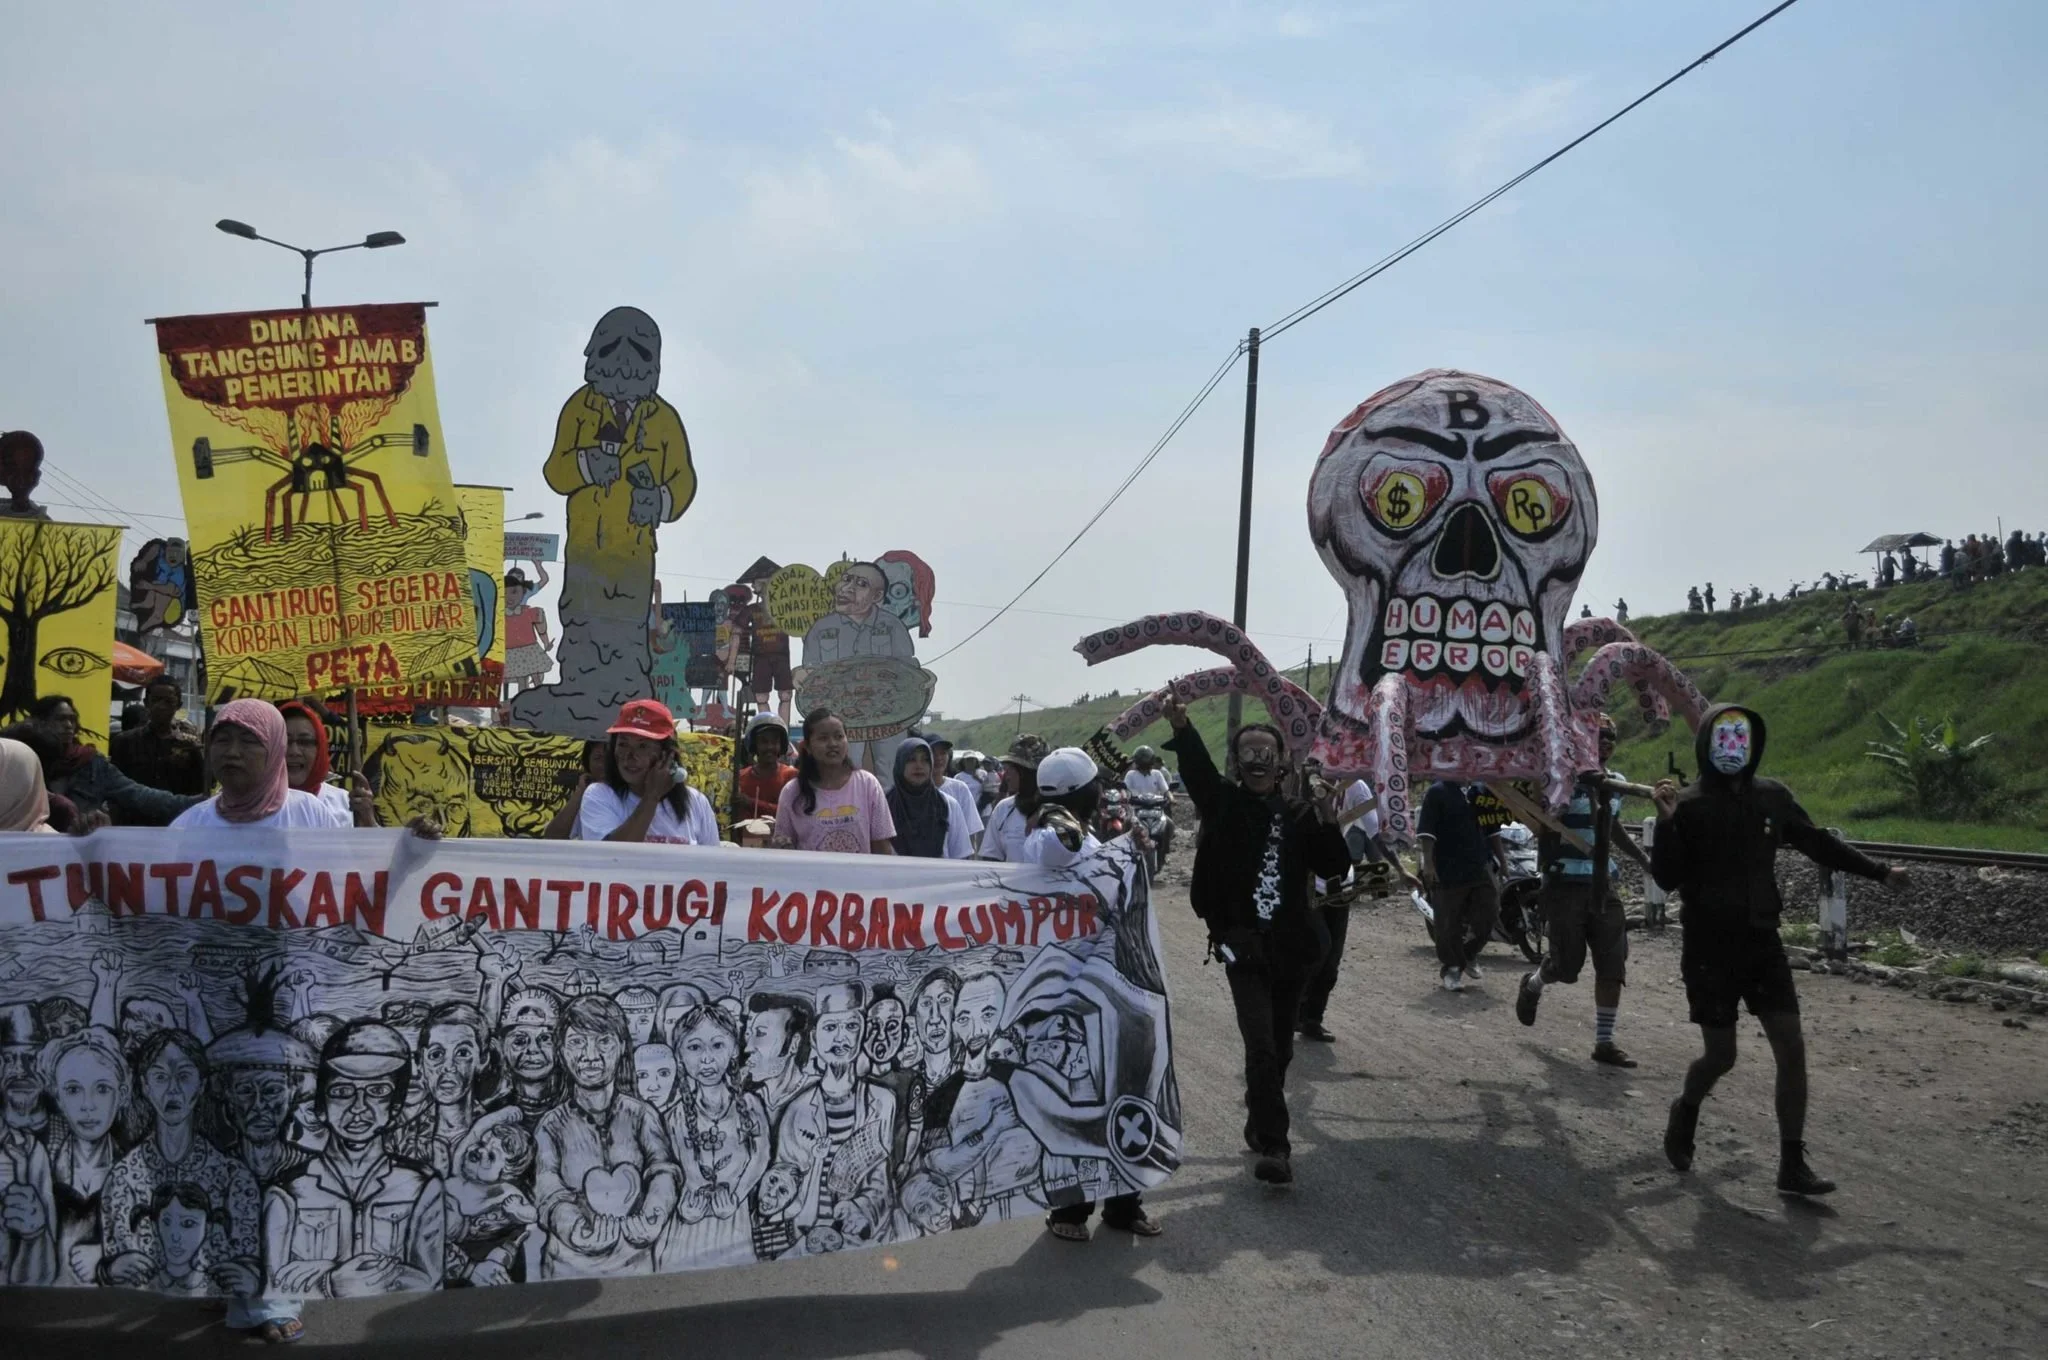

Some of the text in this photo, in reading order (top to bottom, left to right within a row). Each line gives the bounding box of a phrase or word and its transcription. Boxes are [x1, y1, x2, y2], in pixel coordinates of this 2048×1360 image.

[250, 313, 359, 344] DIMANA
[180, 338, 418, 378] TANGGUNG JAWAB
[224, 366, 391, 404] PEMERINTAH
[1439, 389, 1491, 430] B
[1511, 488, 1545, 530] Rp
[768, 584, 806, 603] KAMI
[771, 568, 805, 590] SUDAH
[211, 572, 462, 628] GANTIRUGI SEGERA
[770, 600, 809, 617] LUNASI
[215, 602, 463, 657] KORBAN LUMPUR DILUAR
[1387, 603, 1533, 638] HUMAN
[305, 642, 401, 691] PETA
[1385, 641, 1531, 669] ERROR
[474, 755, 519, 766] BERSATU
[482, 787, 560, 801] KASUS CENTURY
[7, 860, 1099, 951] TUNTASKAN GANTIRUGI KORBAN LUMPUR
